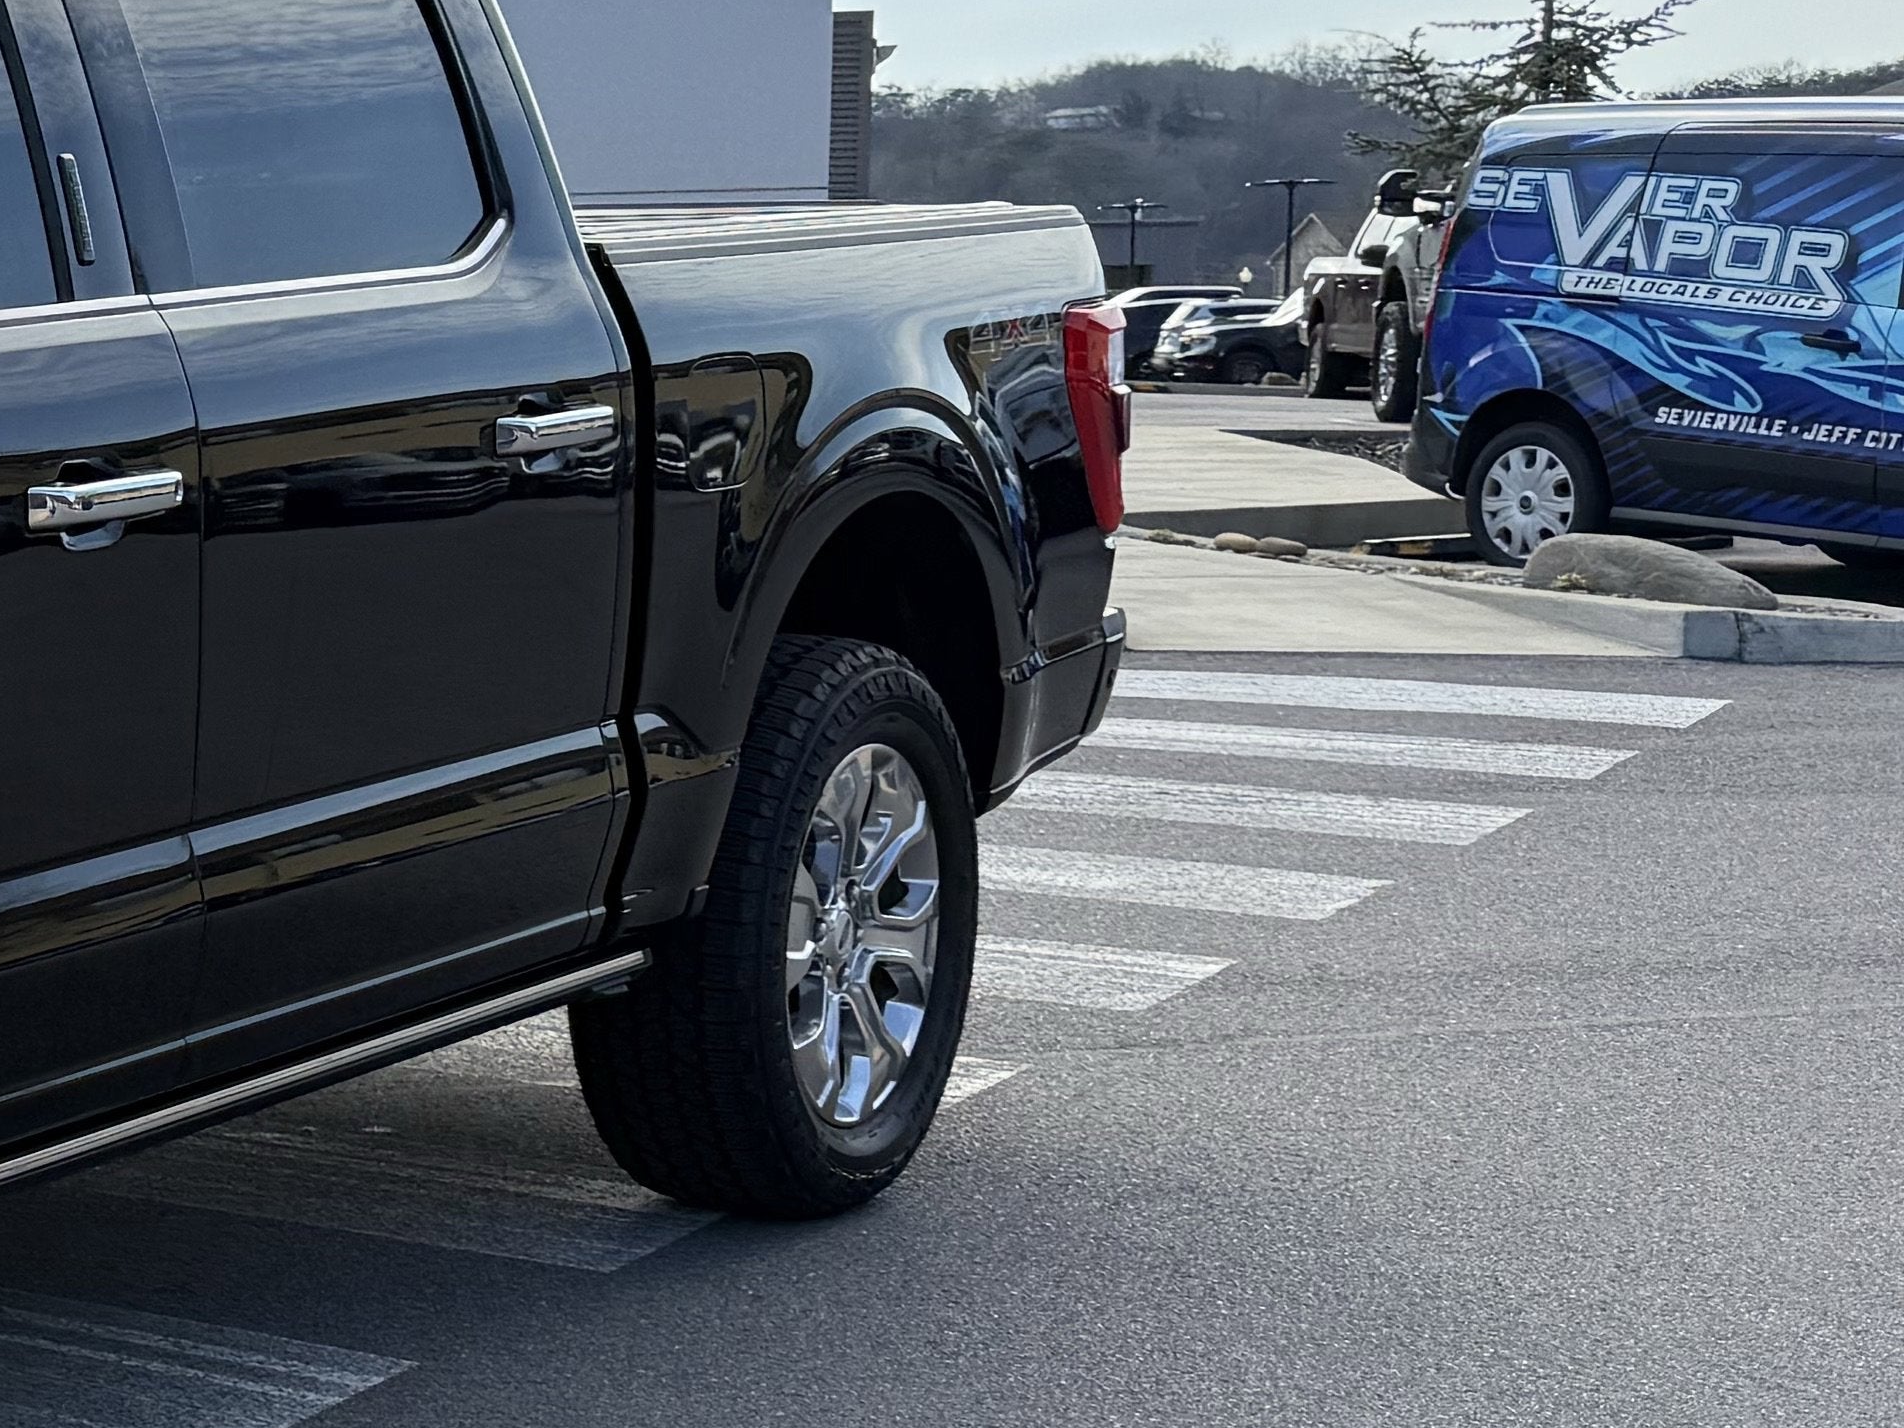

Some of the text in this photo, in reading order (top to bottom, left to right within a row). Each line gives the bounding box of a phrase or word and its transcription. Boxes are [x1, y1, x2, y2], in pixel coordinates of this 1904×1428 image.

[1573, 275, 1826, 312] THE LOCALS CHOICE
[1654, 406, 1904, 452] SEVIERVILLE JEFF CIT
